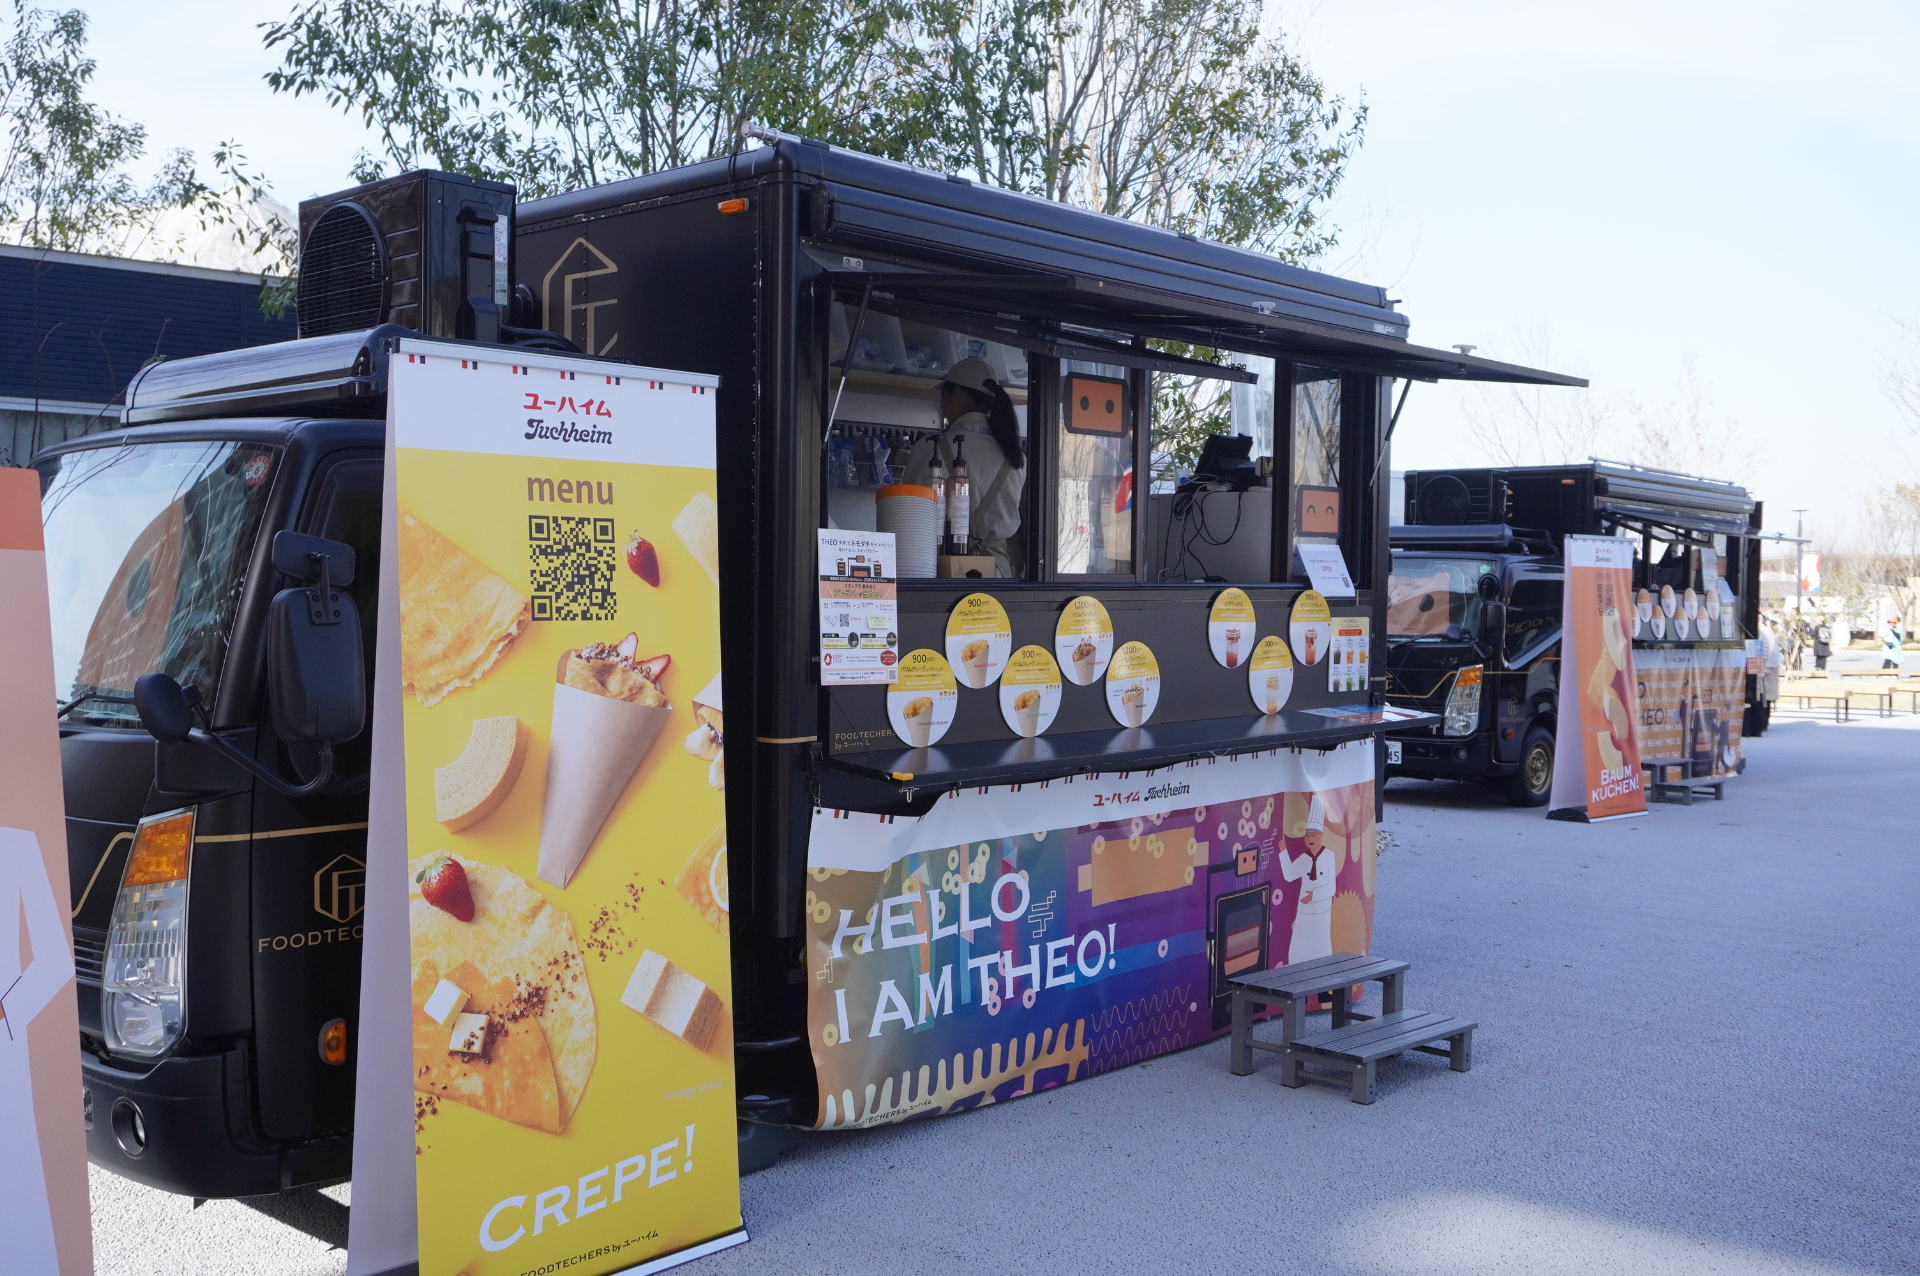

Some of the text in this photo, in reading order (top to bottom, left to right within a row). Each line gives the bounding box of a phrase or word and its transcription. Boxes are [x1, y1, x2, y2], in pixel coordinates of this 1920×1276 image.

[523, 393, 612, 418] ユーハイム
[524, 418, 613, 445] Juchheim
[527, 477, 614, 505] menu
[835, 729, 896, 741] FOODTECHER
[1592, 774, 1640, 803] KUCHEN!
[1601, 764, 1632, 786] BAUM
[1093, 791, 1140, 807] ユーハイム
[832, 872, 1030, 958] HELLO
[834, 923, 1117, 1044] I AM THEO!
[479, 1123, 697, 1252] CREPE!
[612, 1243, 622, 1253] by
[622, 1230, 659, 1248] ユーハイム
